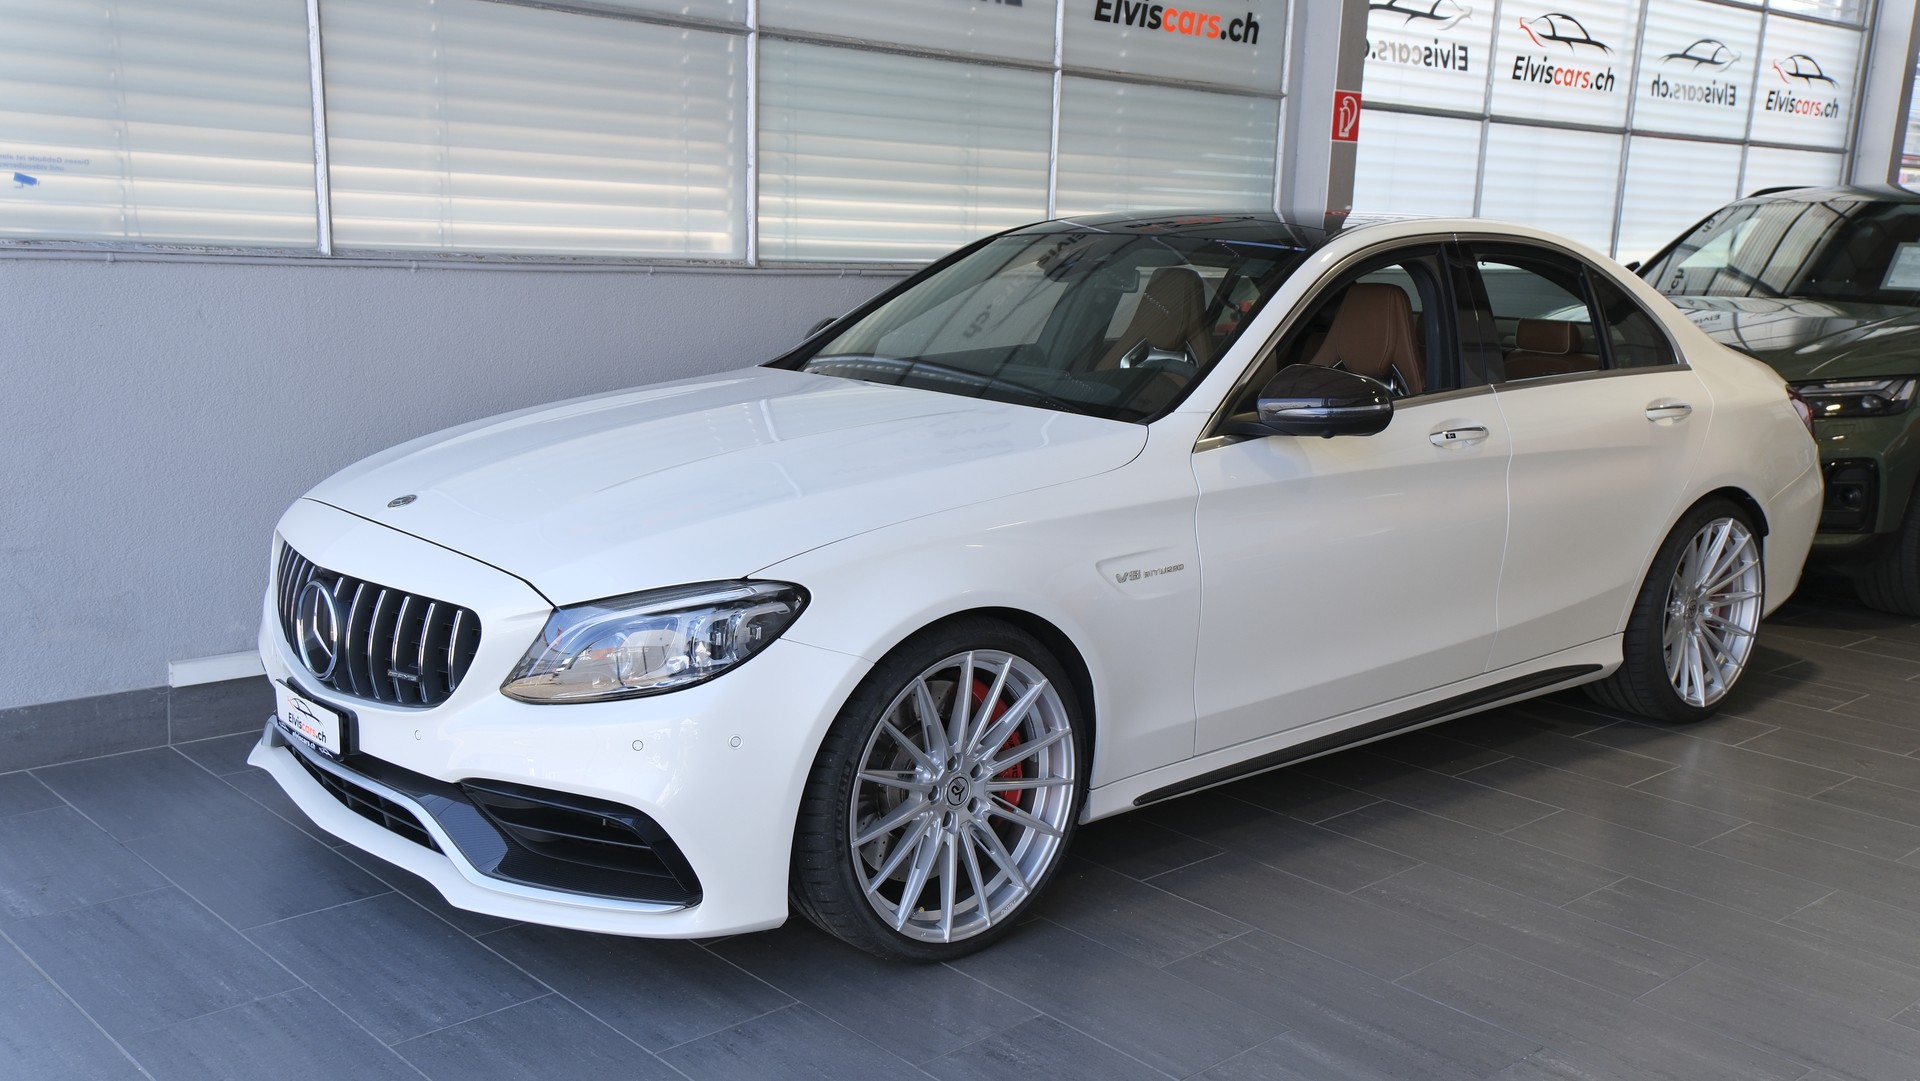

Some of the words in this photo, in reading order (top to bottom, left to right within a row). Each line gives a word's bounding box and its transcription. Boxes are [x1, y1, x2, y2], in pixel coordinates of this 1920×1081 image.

[1094, 0, 1259, 45] Elviscars.ch
[1512, 55, 1615, 92] Elviscars.ch
[1765, 90, 1839, 119] Elviscars.ch
[1115, 569, 1141, 583] V8
[1144, 563, 1185, 578] BITURBO
[288, 712, 327, 743] Elviscars.ch
